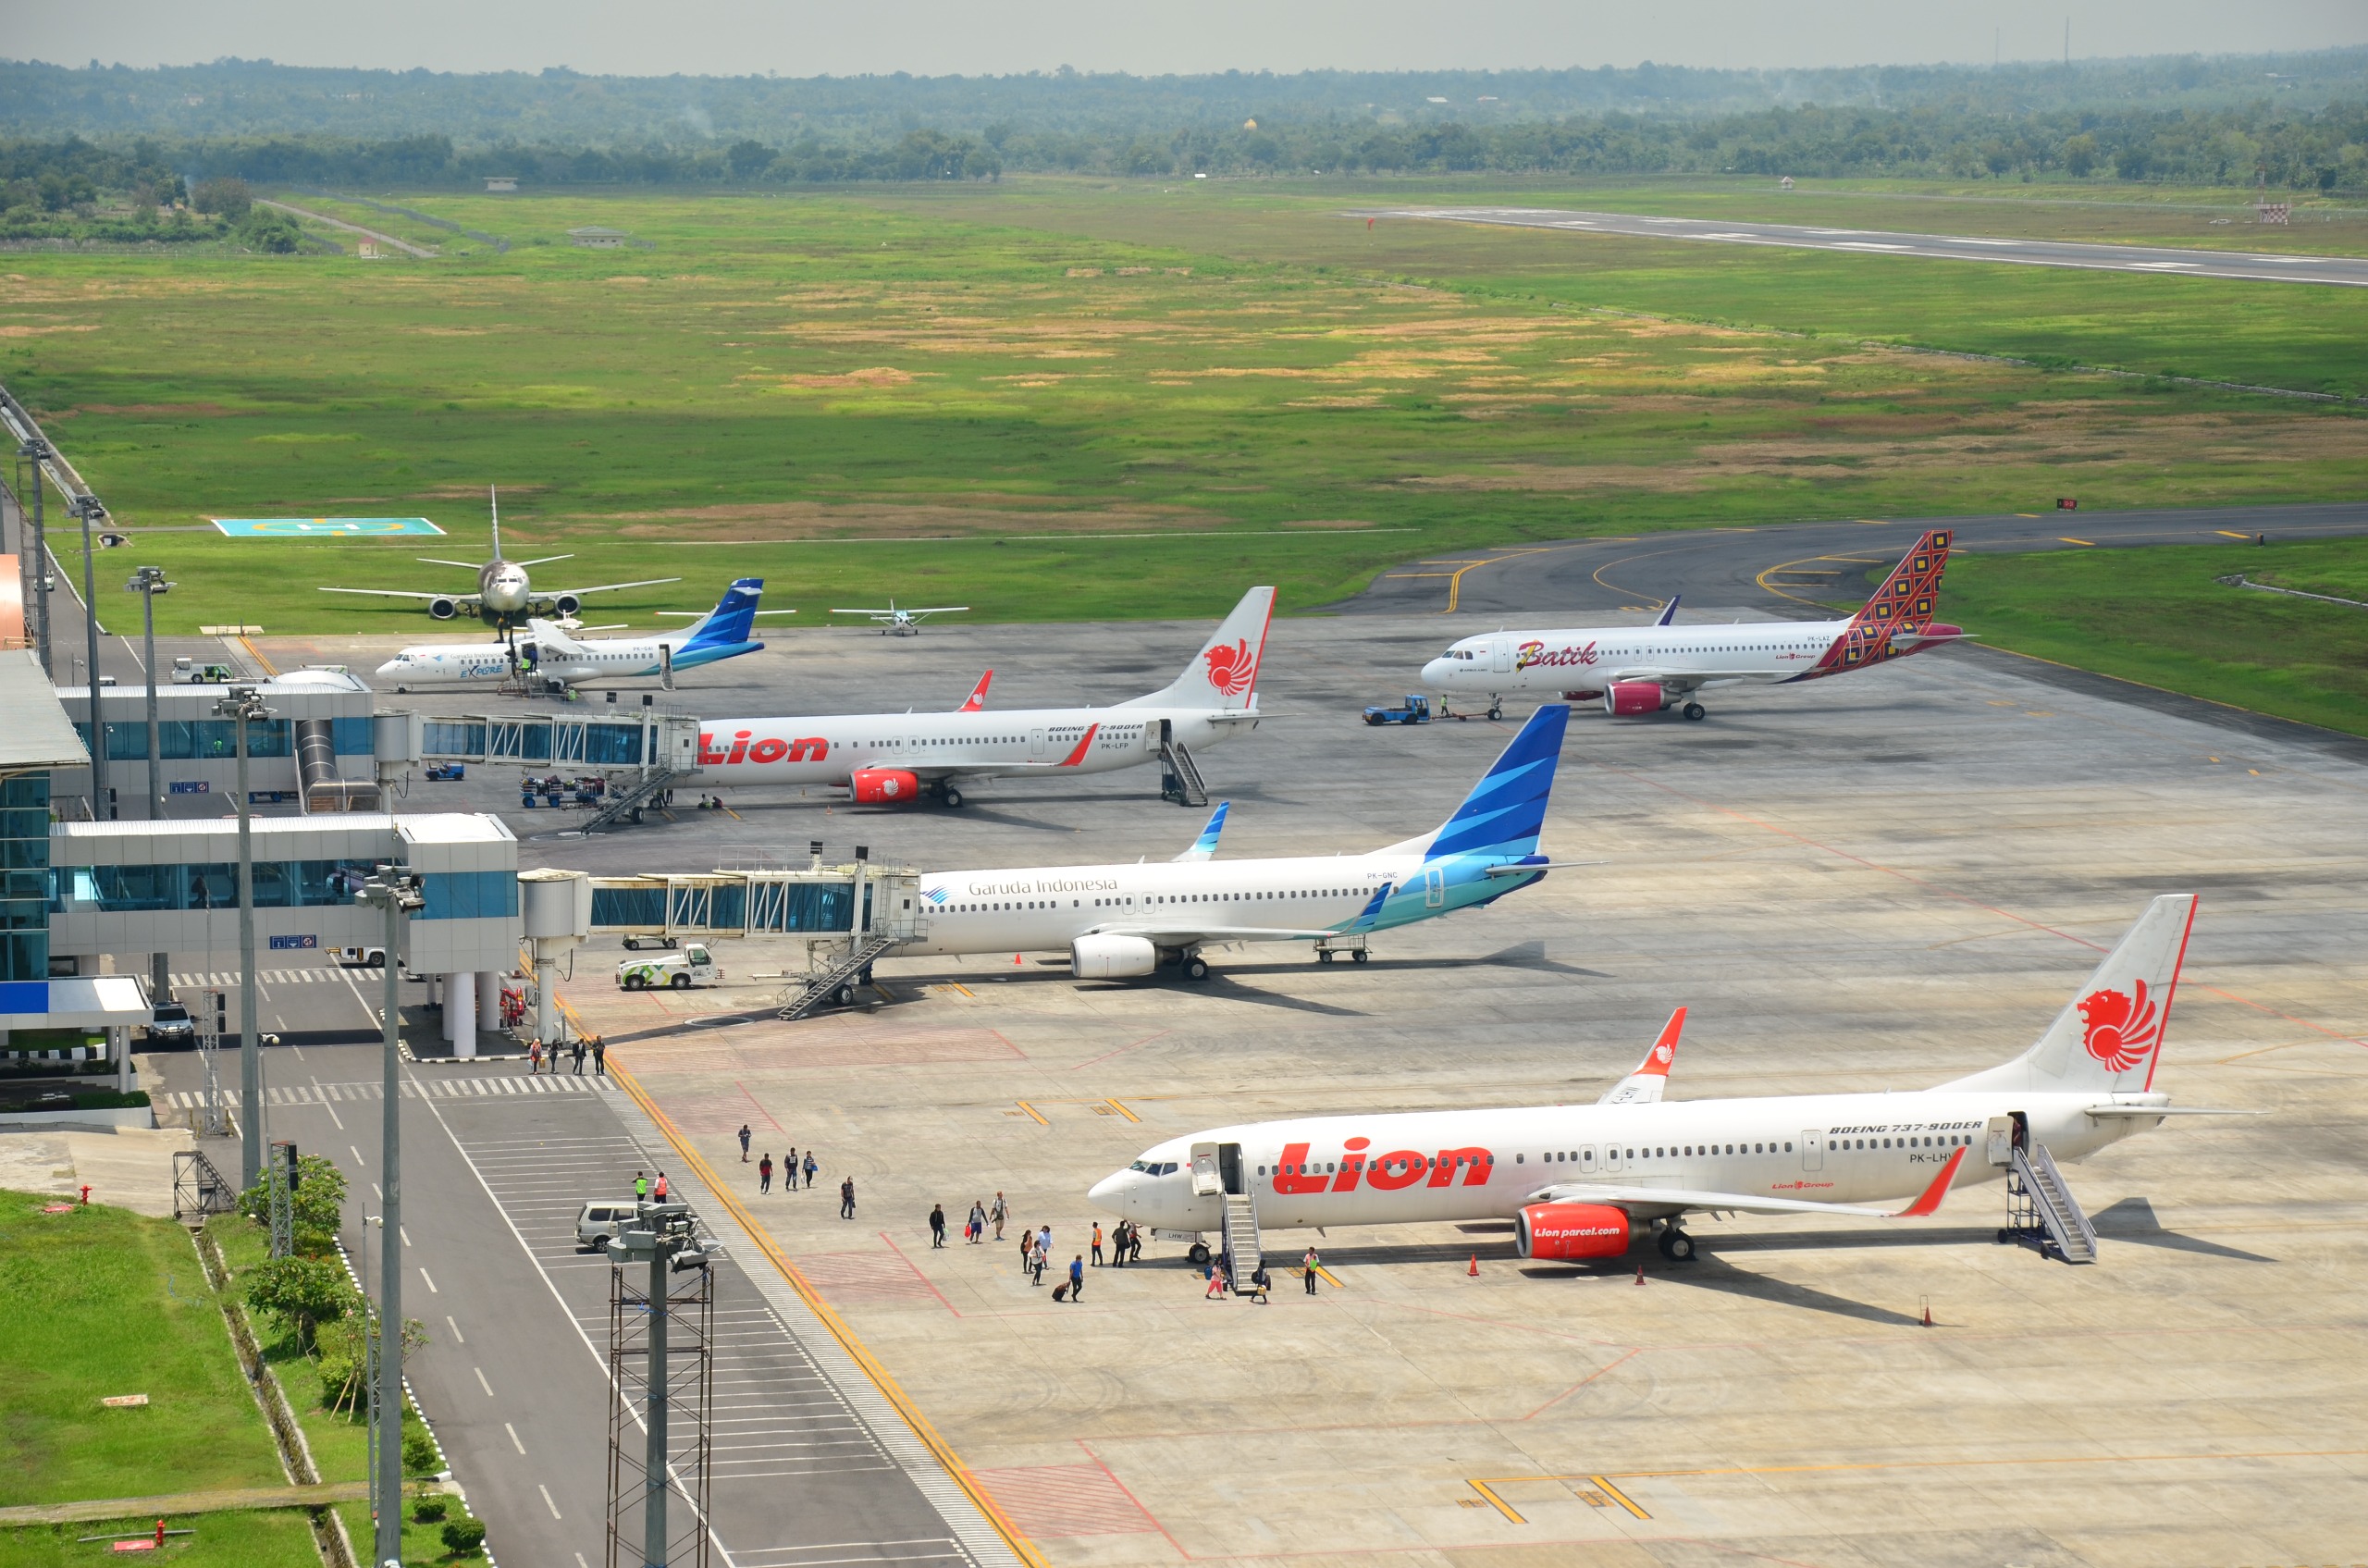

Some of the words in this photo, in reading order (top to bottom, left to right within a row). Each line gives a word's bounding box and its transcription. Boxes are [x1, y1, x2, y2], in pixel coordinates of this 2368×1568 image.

[1518, 640, 1599, 667] Batik
[460, 665, 504, 679] EXPLORE
[697, 730, 831, 765] Lion
[968, 881, 1031, 895] Garuda
[1036, 879, 1118, 893] Indonesia
[1829, 1125, 1888, 1134] BOEING
[1892, 1120, 1983, 1132] 737-900ER
[1272, 1136, 1495, 1195] Lion
[1534, 1228, 1560, 1238] Lion
[1560, 1227, 1621, 1239] parcel.com
